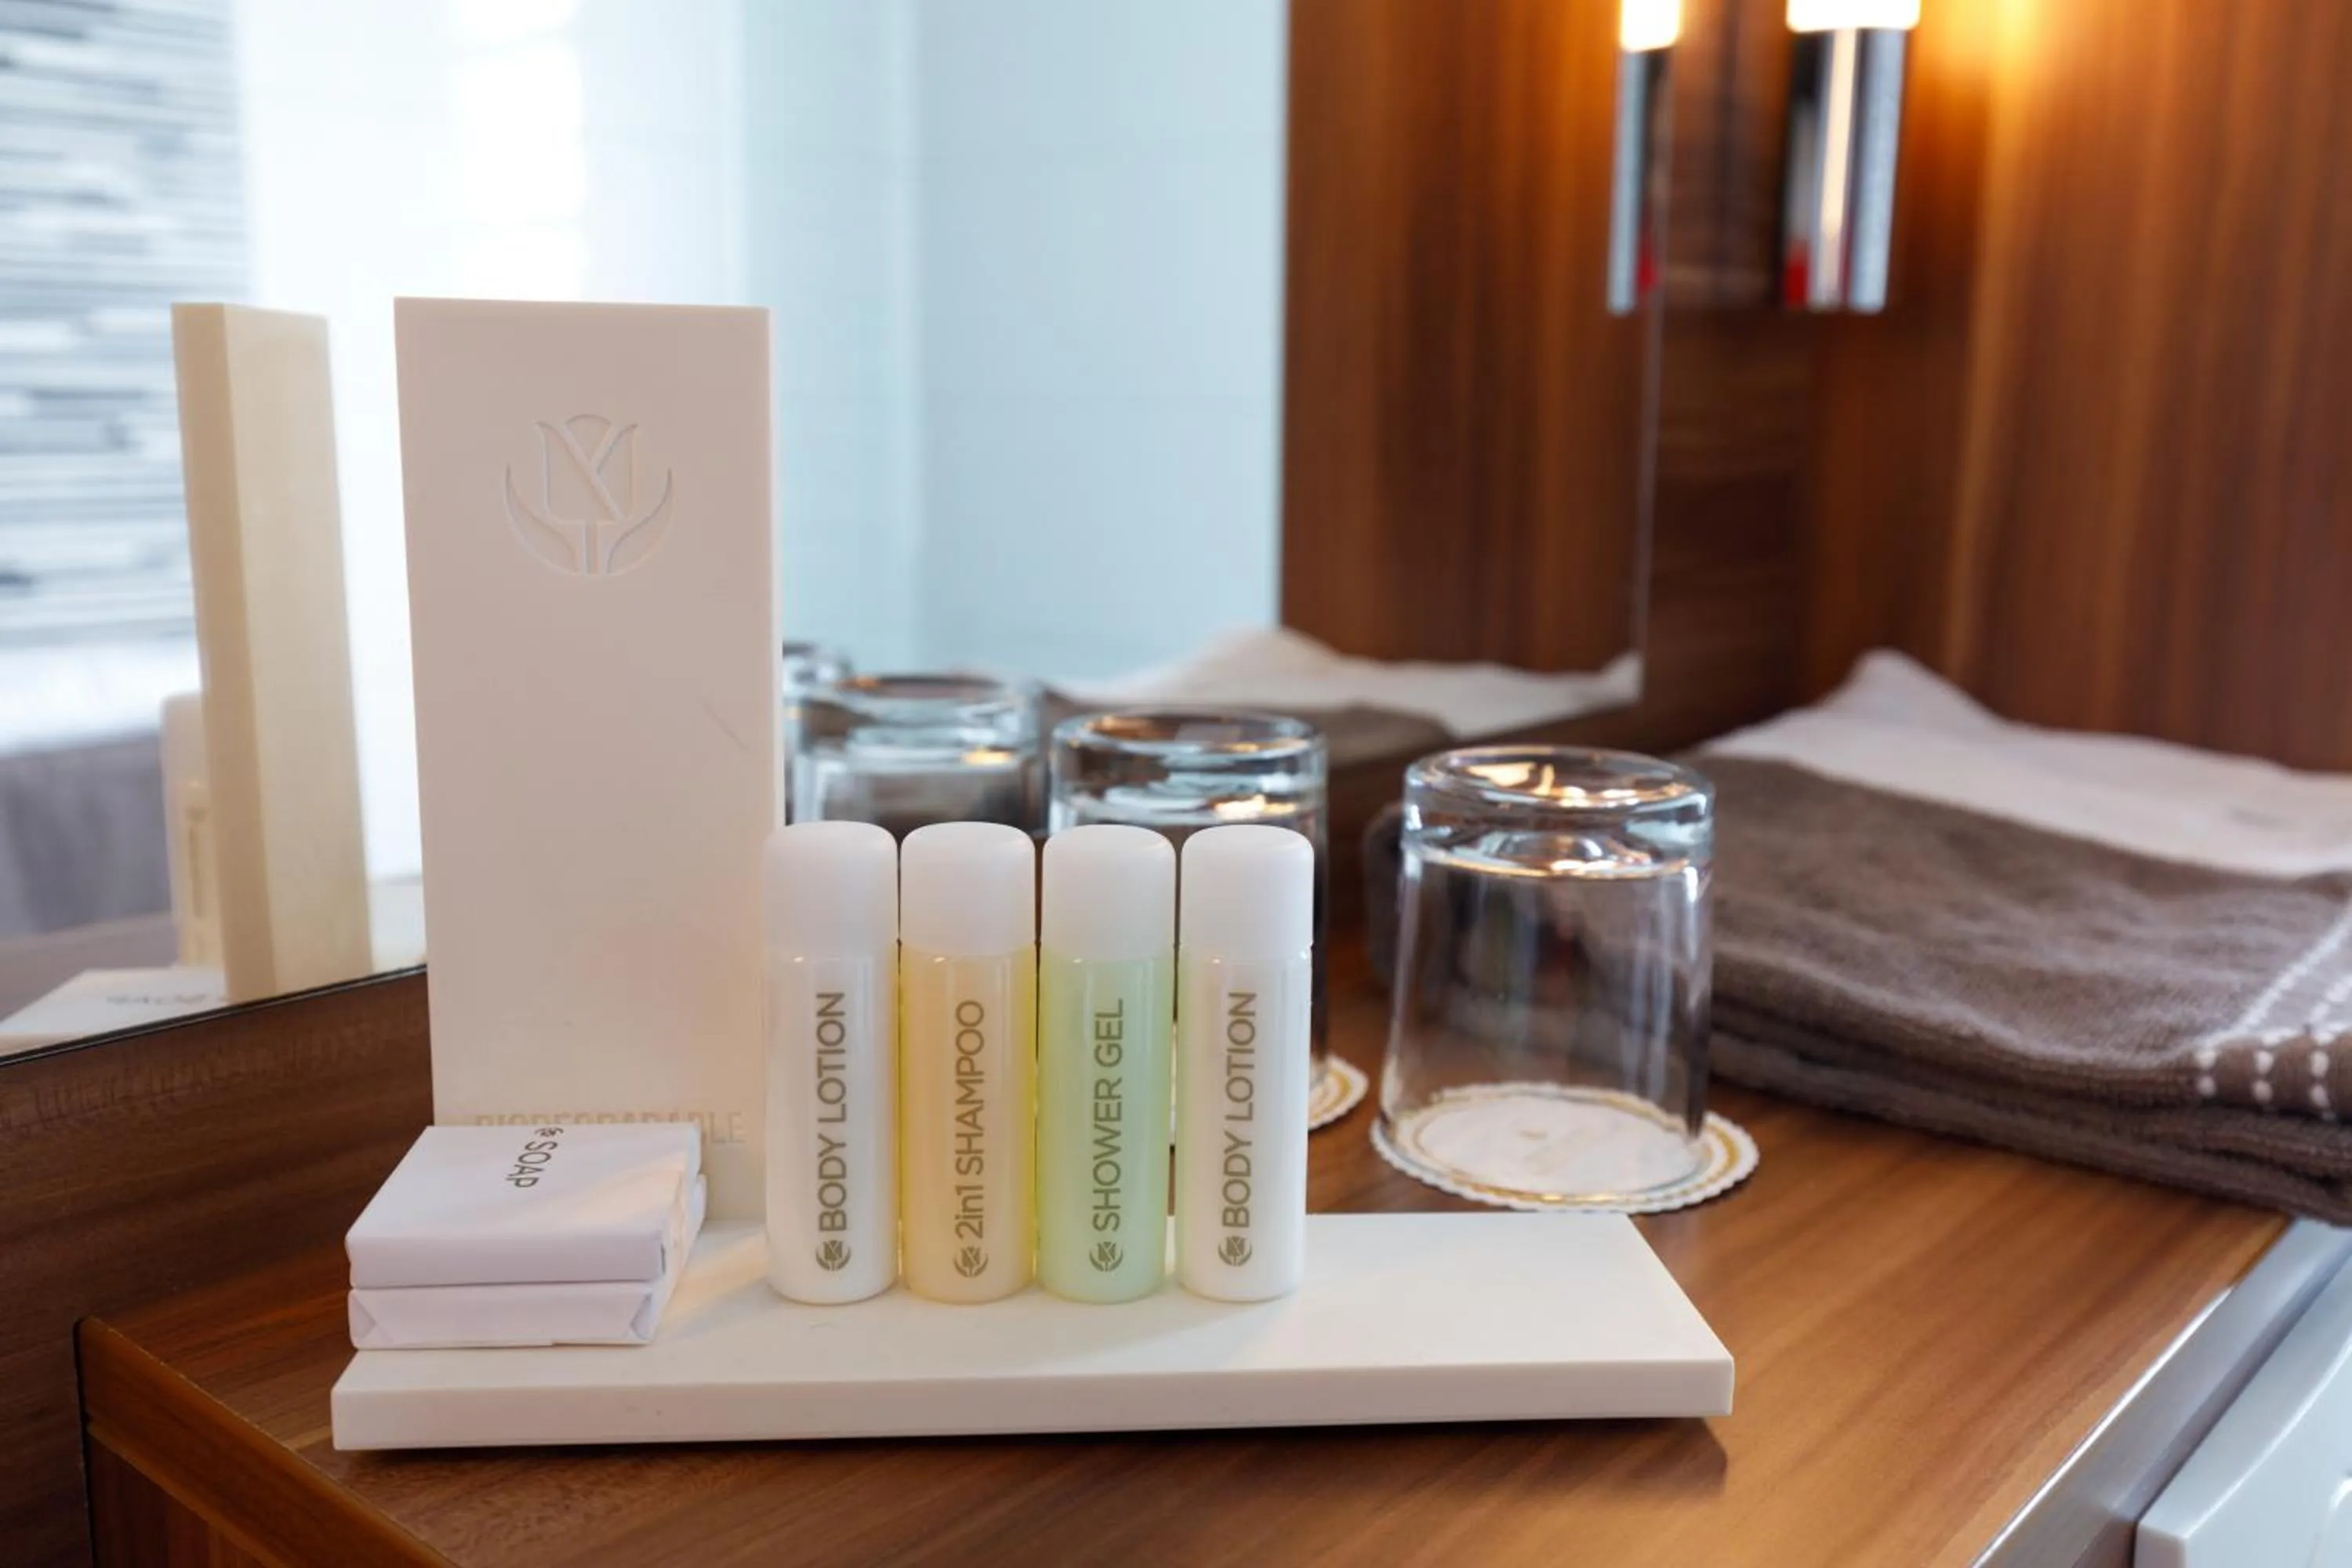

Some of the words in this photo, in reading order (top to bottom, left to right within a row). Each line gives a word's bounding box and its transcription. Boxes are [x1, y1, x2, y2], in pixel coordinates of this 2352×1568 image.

[816, 993, 846, 1123] LOTION
[1094, 999, 1123, 1067] GEL
[1225, 993, 1257, 1121] LOTION
[955, 1000, 984, 1175] SHAMPOO
[505, 1141, 558, 1188] SOAP
[818, 1133, 847, 1232] BODY
[1092, 1077, 1122, 1232] SHOWER
[1222, 1131, 1252, 1228] BODY
[955, 1185, 984, 1239] 2in1
